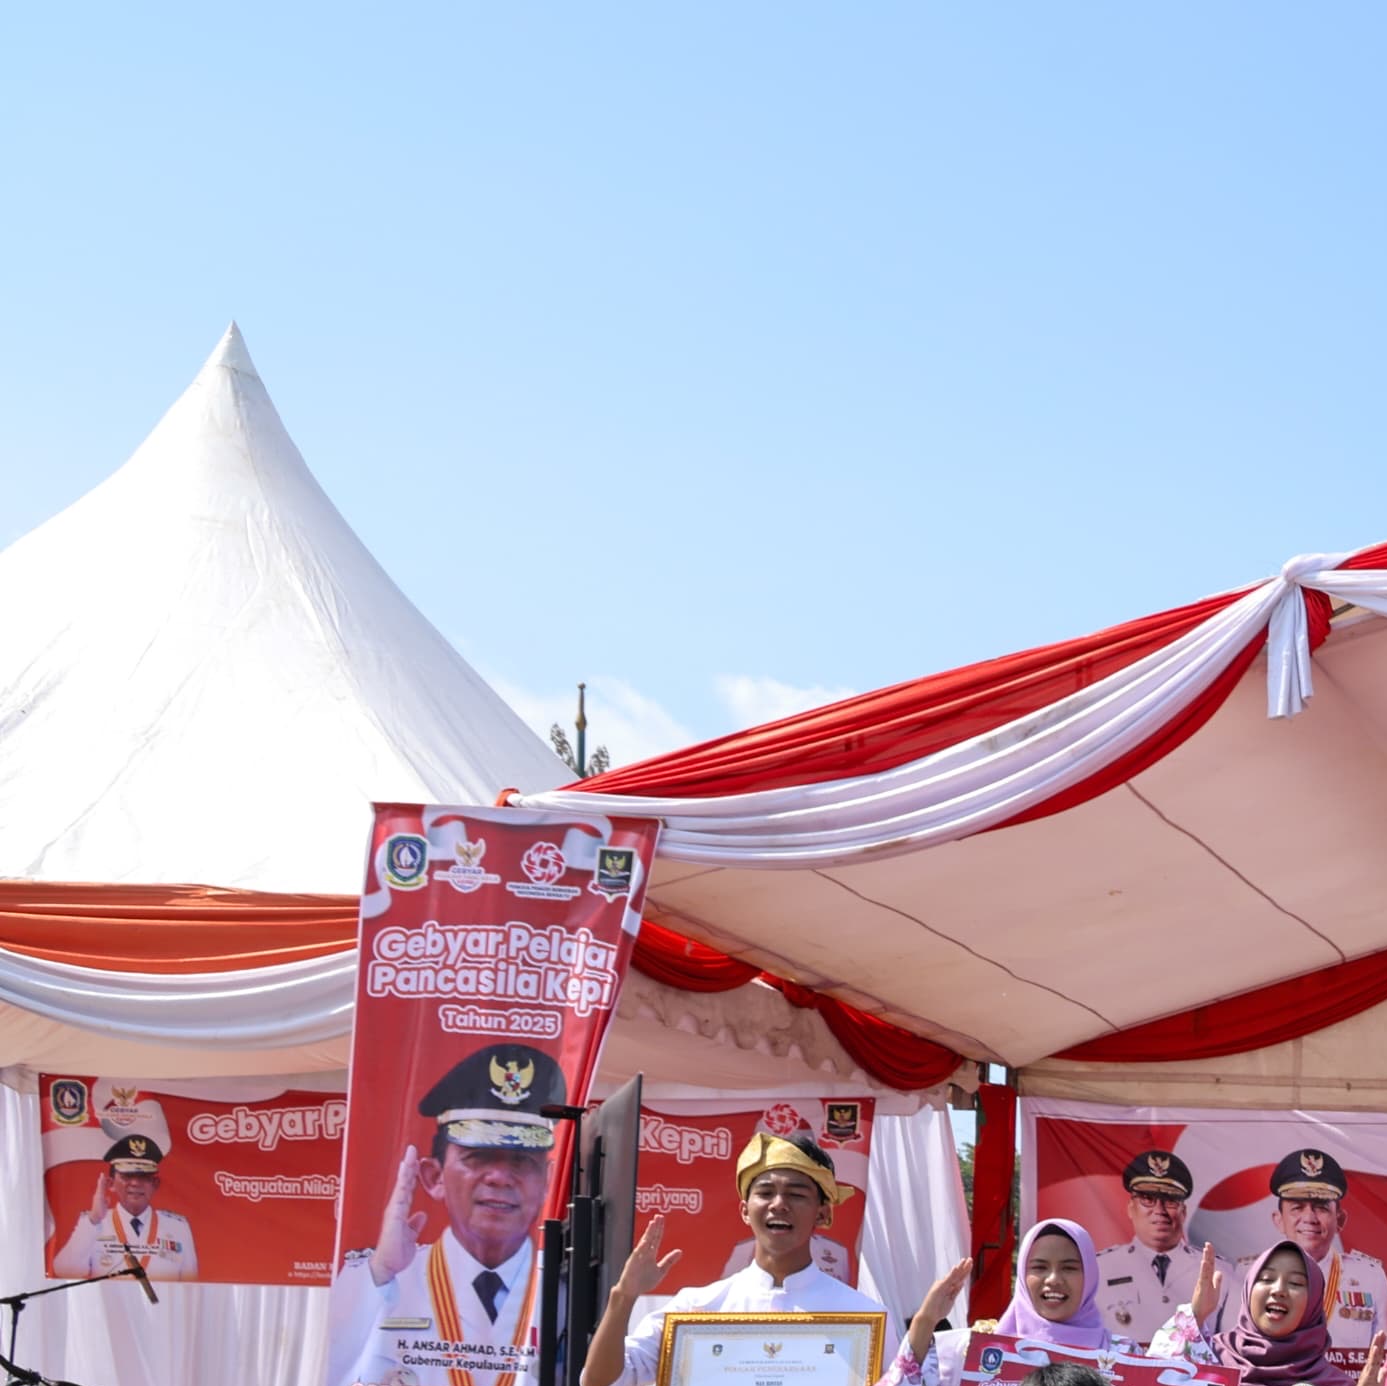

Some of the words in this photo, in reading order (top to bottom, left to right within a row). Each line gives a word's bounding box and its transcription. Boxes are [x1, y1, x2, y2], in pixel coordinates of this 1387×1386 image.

[377, 925, 503, 965] Gebyar
[375, 959, 537, 997] Pancasila
[446, 1011, 505, 1030] Tahun
[510, 1012, 556, 1033] 2025
[191, 1109, 320, 1146] Gebyar
[640, 1119, 729, 1160] Kepri
[664, 1190, 698, 1210] yang
[398, 1339, 408, 1349] H.
[413, 1341, 449, 1352] ANSAR
[452, 1344, 496, 1356] AHMAD,
[402, 1355, 453, 1367] Gubernur
[456, 1359, 511, 1371] Kepulauan
